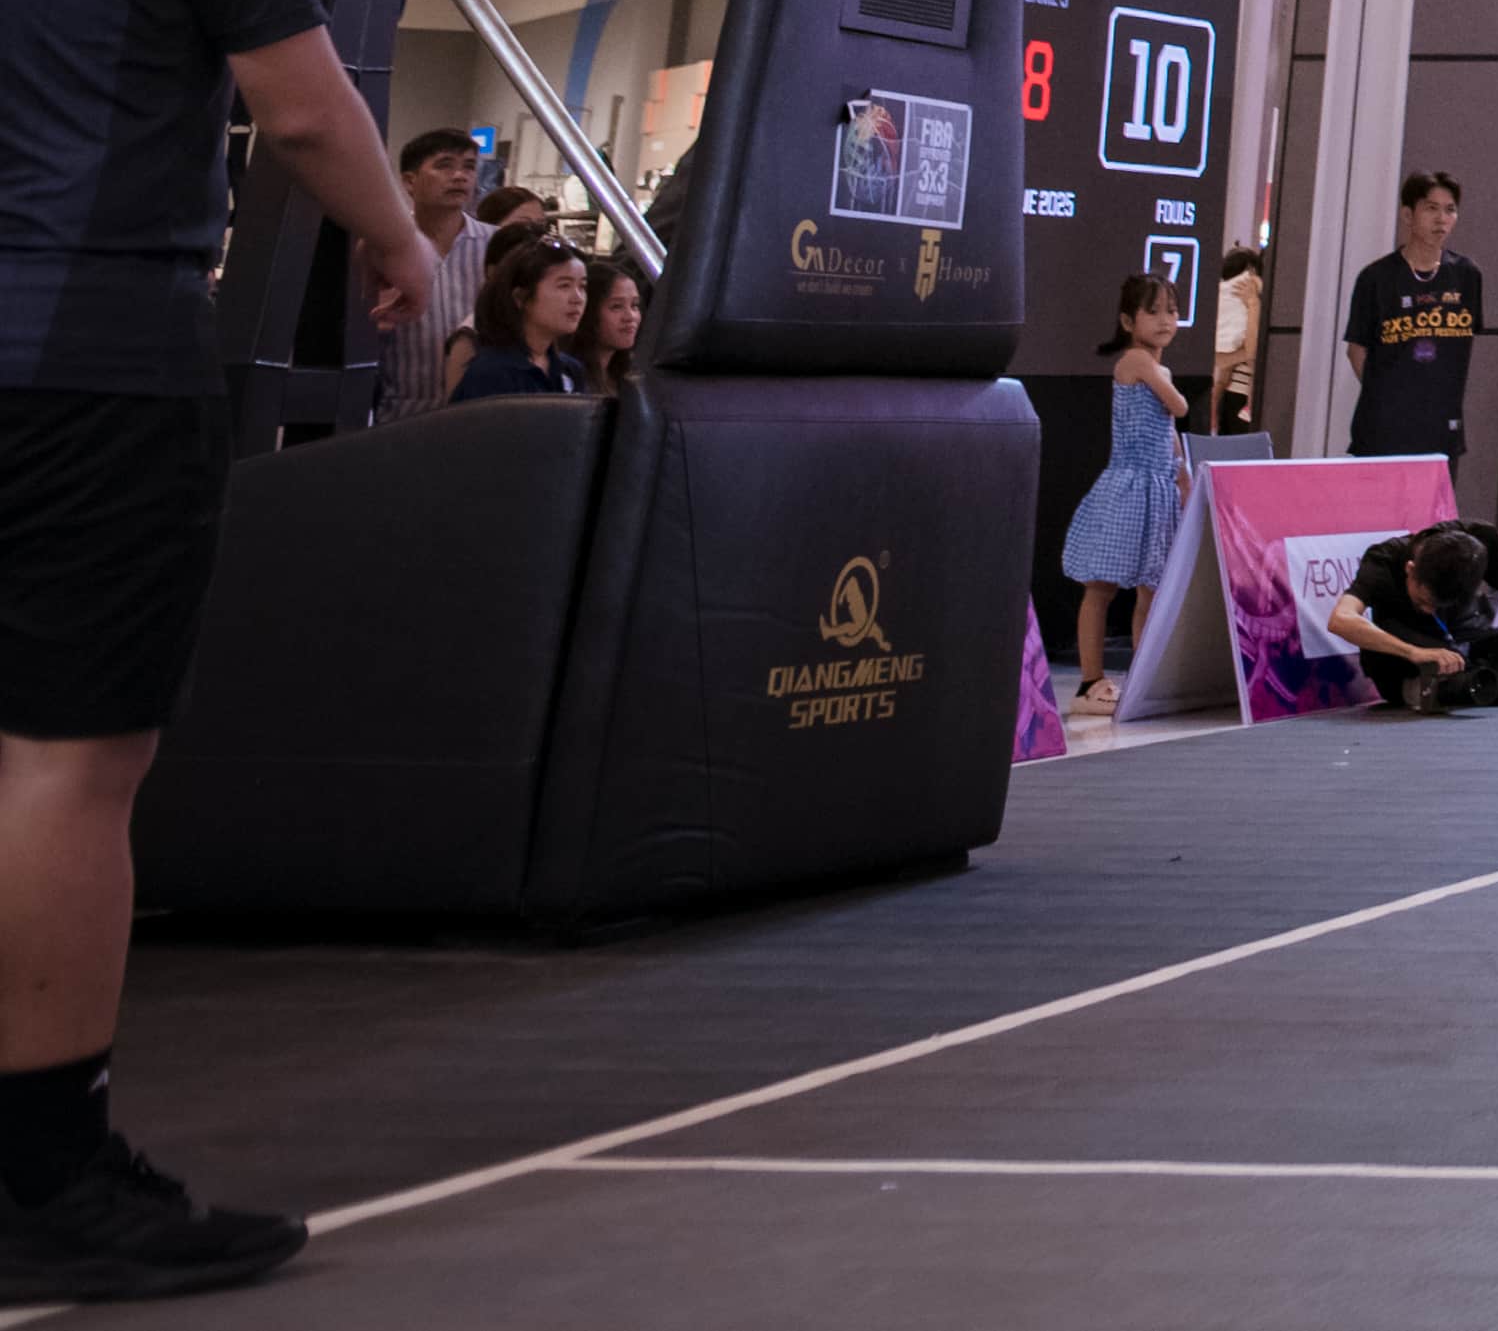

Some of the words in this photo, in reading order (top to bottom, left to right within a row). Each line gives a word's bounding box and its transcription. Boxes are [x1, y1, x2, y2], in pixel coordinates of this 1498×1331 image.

[1123, 39, 1190, 143] 10
[920, 118, 954, 149] FIBA
[918, 159, 950, 195] 3x3
[1038, 191, 1076, 218] 2025
[1155, 199, 1196, 227] FOULS
[938, 256, 992, 290] Hoops
[767, 654, 925, 698] QIANGMENG
[788, 690, 897, 729] SPORTS
